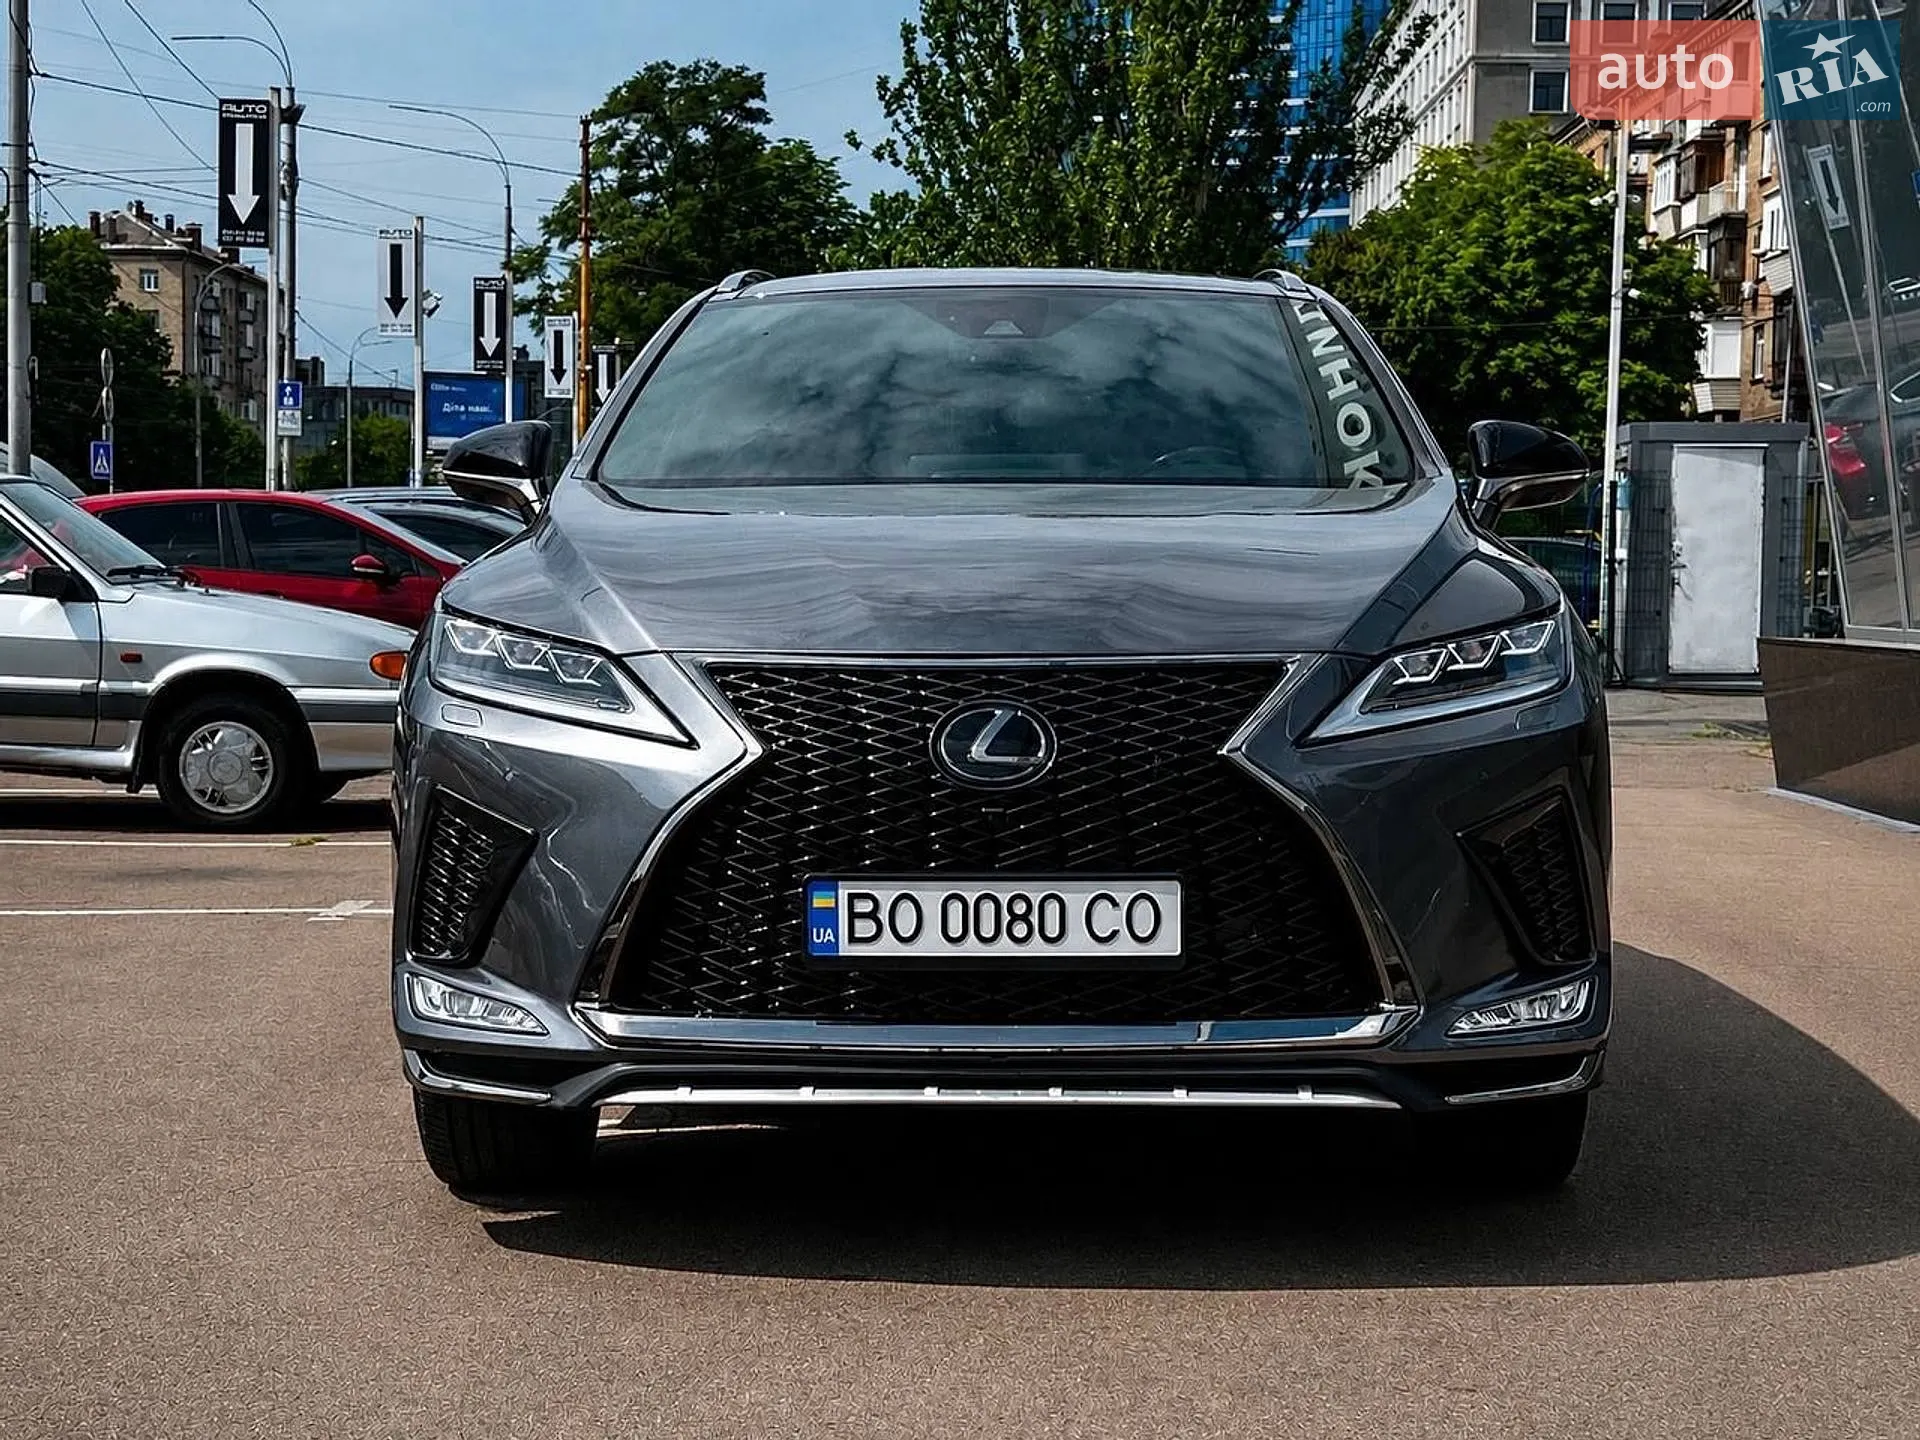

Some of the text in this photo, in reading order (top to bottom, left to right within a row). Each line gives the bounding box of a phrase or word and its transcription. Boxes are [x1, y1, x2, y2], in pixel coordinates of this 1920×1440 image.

[222, 103, 267, 114] AUTO
[846, 892, 1162, 944] BO 0080 CO
[813, 928, 836, 944] UA
